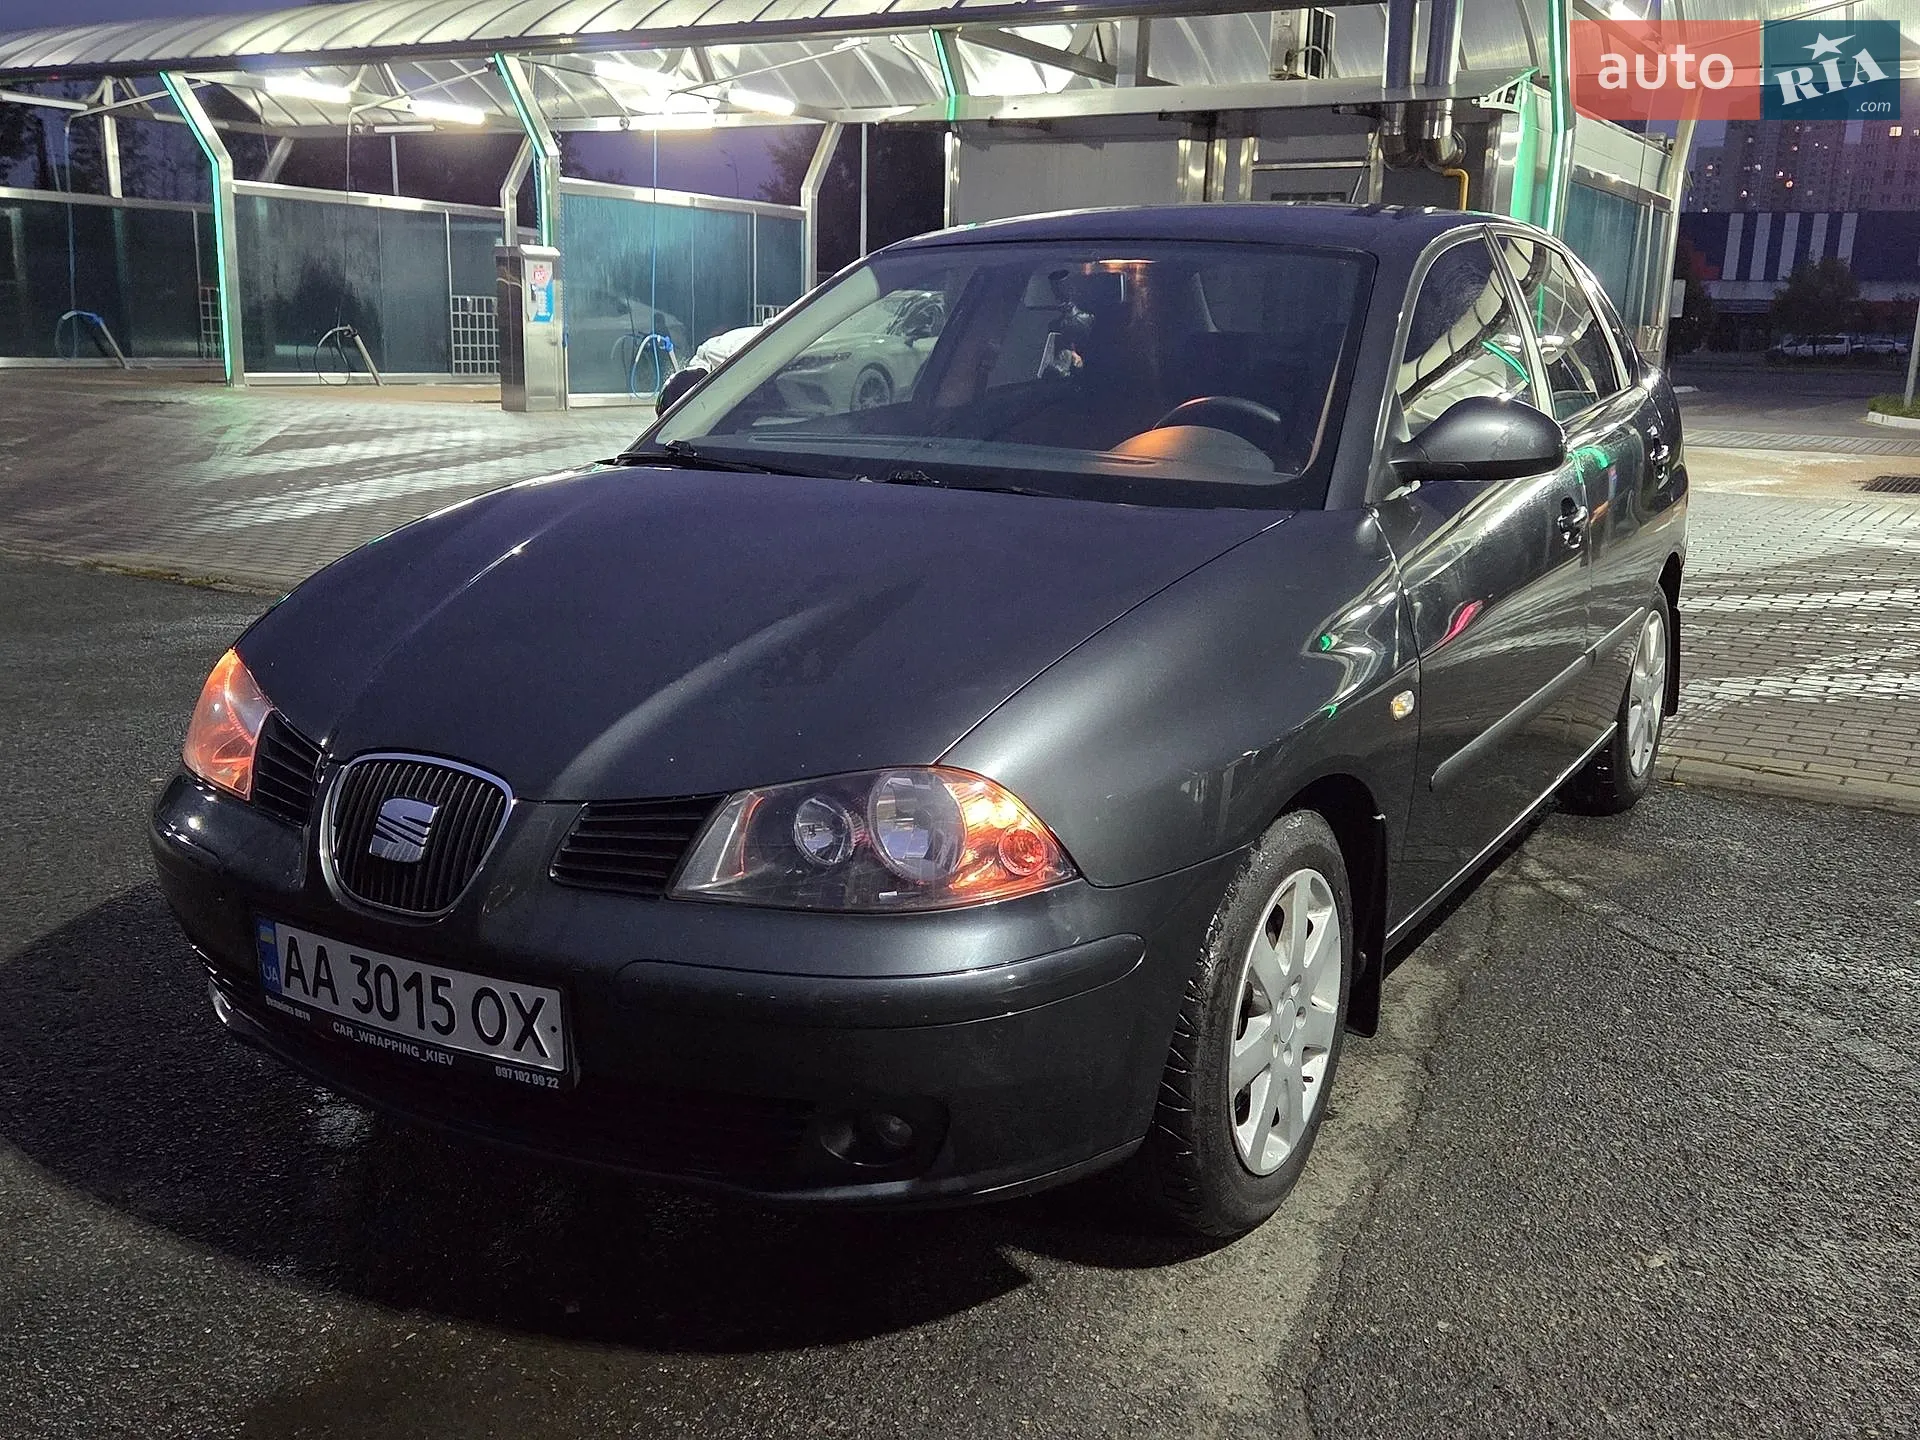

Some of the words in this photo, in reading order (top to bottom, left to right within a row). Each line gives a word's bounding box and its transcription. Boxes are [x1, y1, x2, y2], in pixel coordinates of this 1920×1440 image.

[262, 963, 280, 985] UA
[284, 935, 340, 1006] AA
[350, 954, 457, 1036] 3015
[471, 986, 550, 1059] OX
[332, 1021, 455, 1066] CAR_WRAPPING_KIEV
[514, 1069, 531, 1083] 102
[546, 1076, 560, 1089] 22
